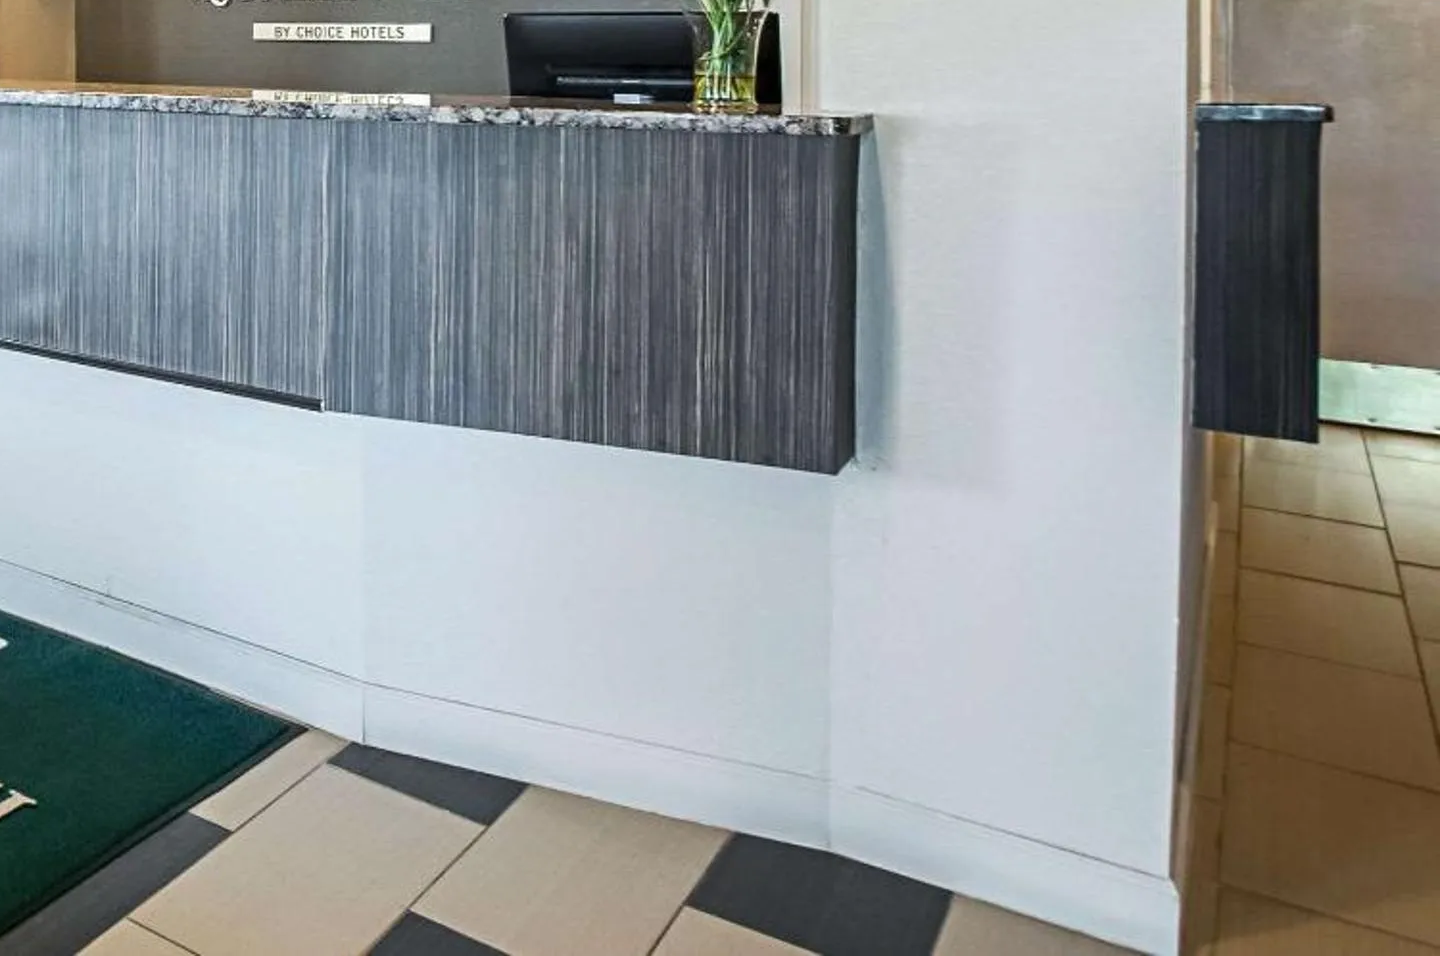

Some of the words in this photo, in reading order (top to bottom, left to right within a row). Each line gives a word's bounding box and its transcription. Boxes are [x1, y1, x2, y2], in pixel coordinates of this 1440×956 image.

[274, 26, 291, 39] BY
[295, 26, 344, 39] CHOICE
[350, 26, 405, 39] HOTELS
